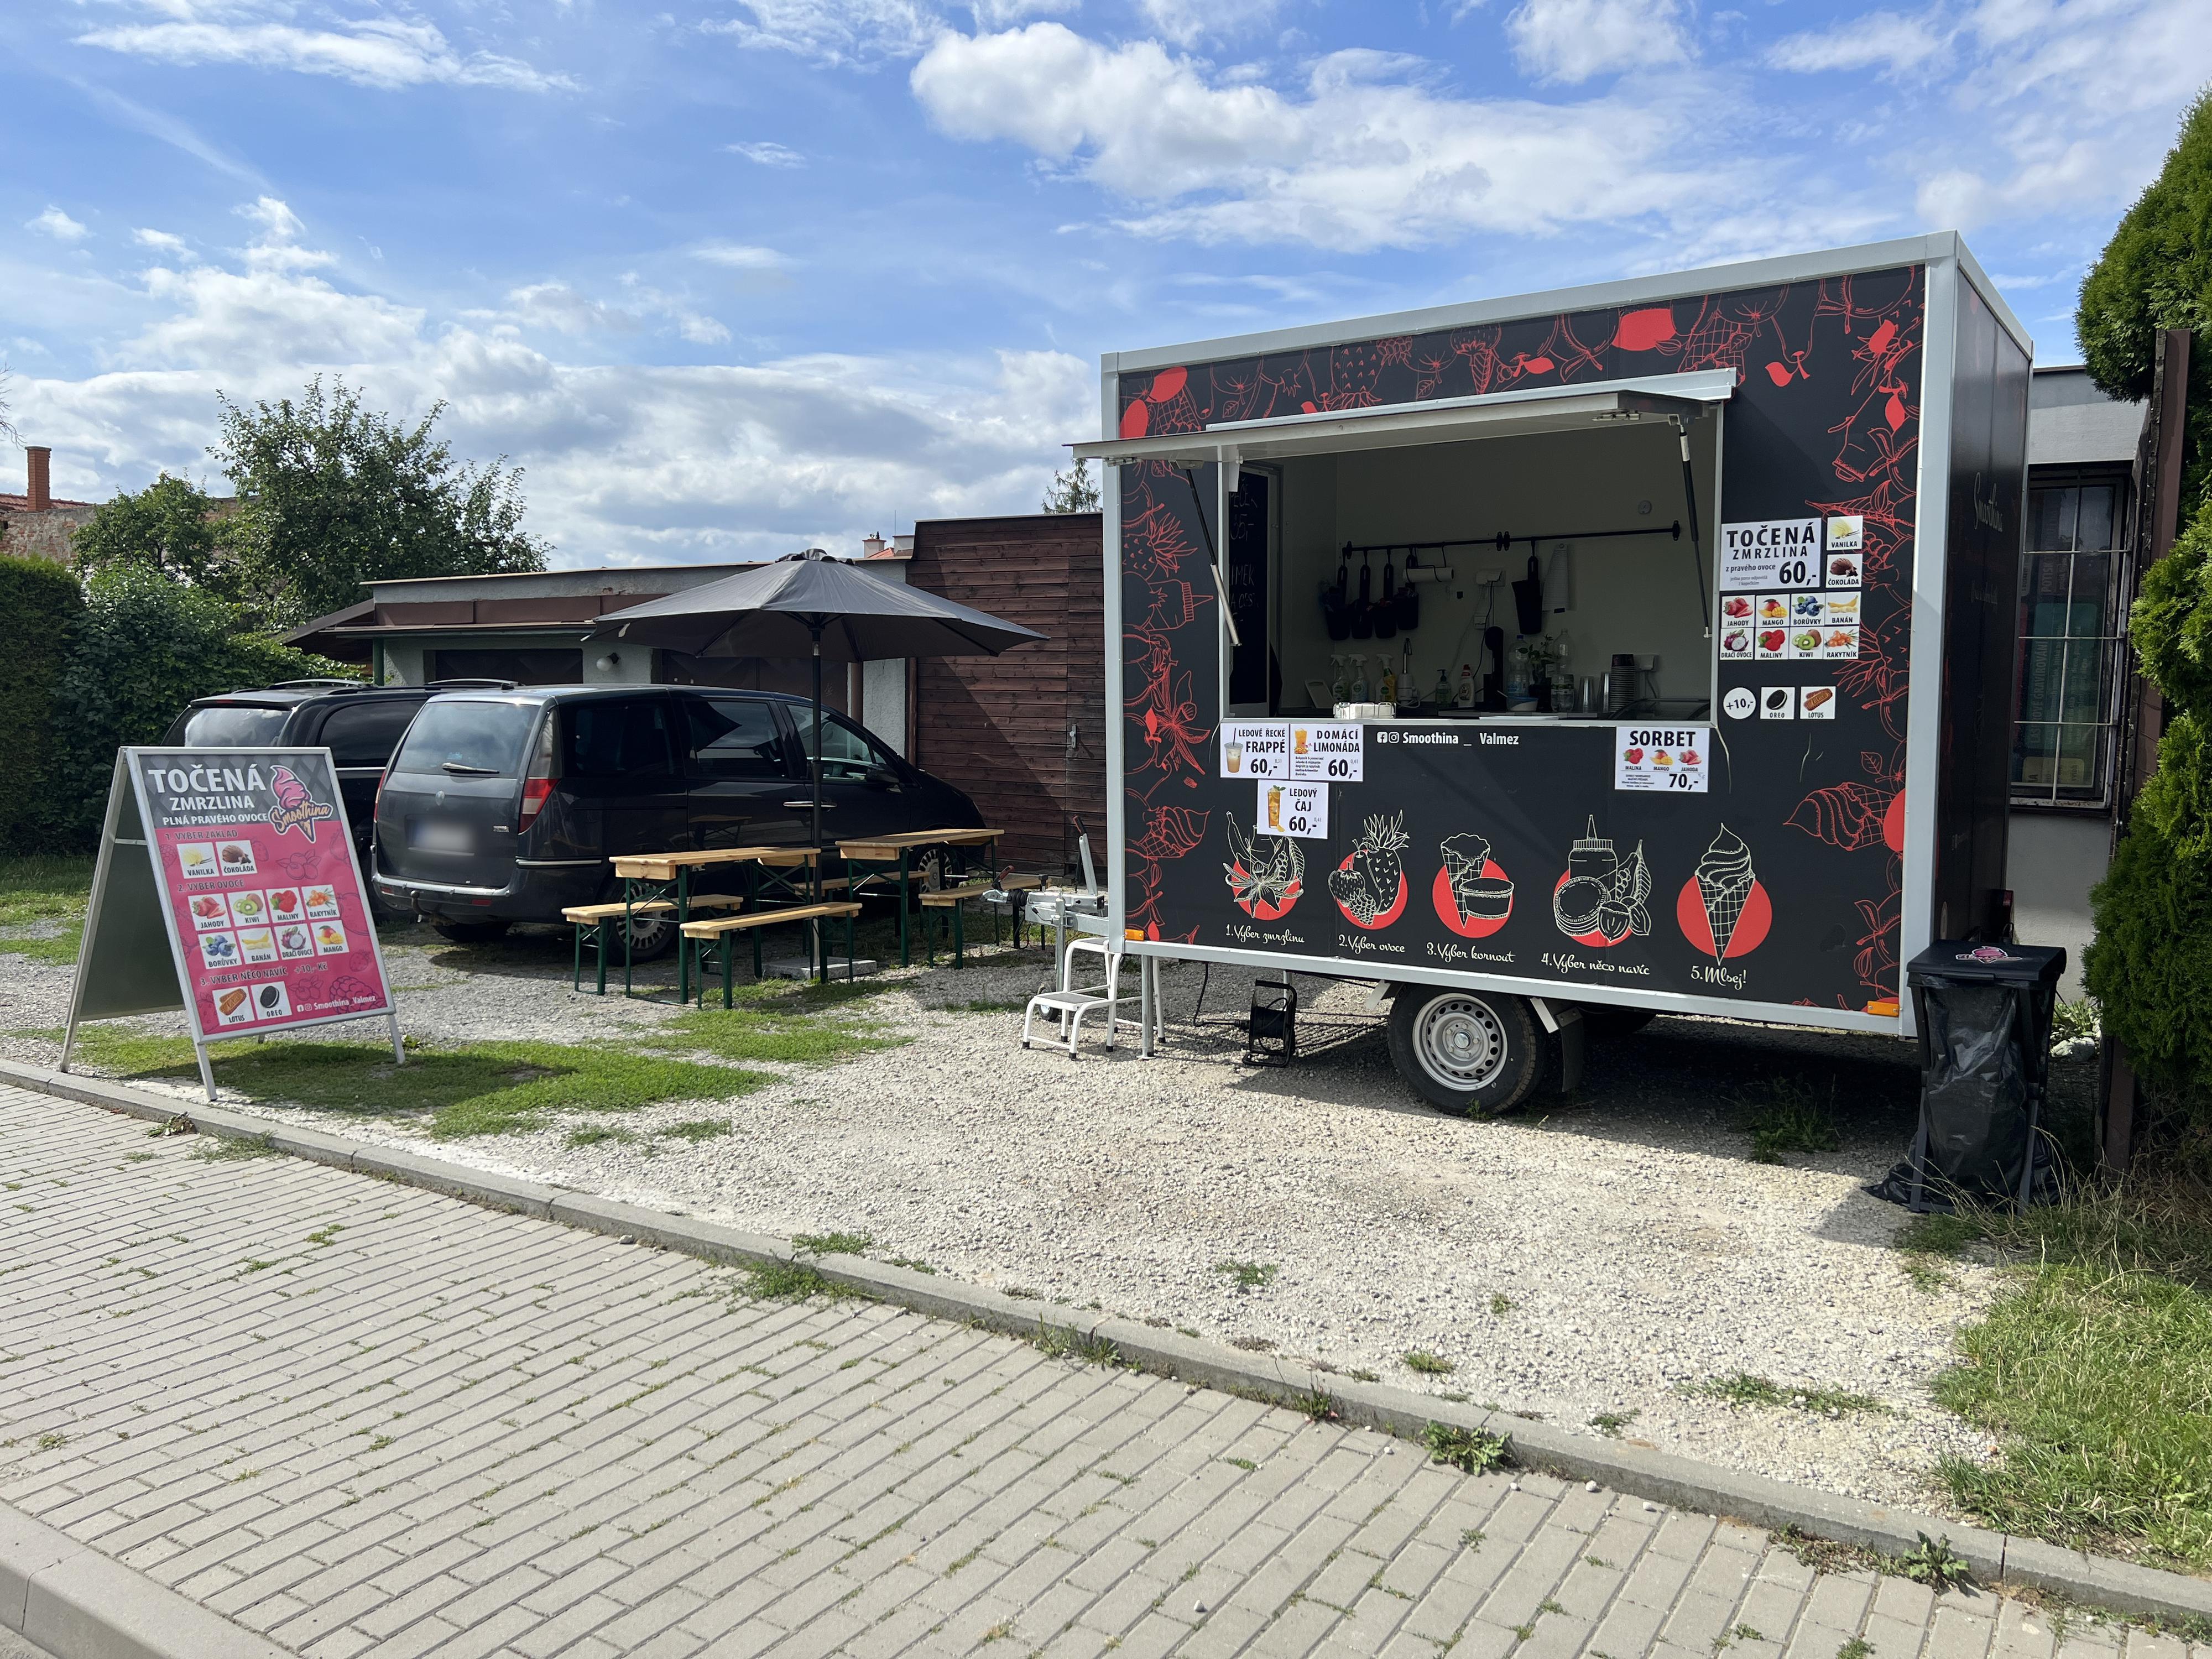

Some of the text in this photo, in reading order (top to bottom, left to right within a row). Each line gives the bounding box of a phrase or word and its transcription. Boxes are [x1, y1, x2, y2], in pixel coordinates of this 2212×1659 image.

[1726, 522, 1815, 547] TOČENÁ
[1733, 546, 1807, 560] ZMRZLINA
[1730, 564, 1756, 573] pravého
[1779, 560, 1817, 586] 60,-
[1828, 577, 1859, 586] ČOKOLÁDA
[1793, 617, 1822, 625] BORŮVKY
[1726, 698, 1754, 710] +10,-
[1239, 728, 1285, 737] LEDOVÉ ŘECKÉ
[1317, 729, 1359, 739] DOMÁCÍ
[1403, 732, 1459, 744] Smoothina
[1479, 732, 1519, 745] Valmez
[1630, 730, 1695, 747] SORBET
[1246, 739, 1285, 753] FRAPPÉ
[1313, 740, 1360, 753] LIMONÁDA
[1250, 758, 1277, 776] 60,-
[1328, 759, 1357, 779] 60,-
[148, 764, 267, 793] TOČENÁ
[1669, 773, 1698, 790] 70,-
[1290, 788, 1317, 797] LEDOVÝ
[169, 795, 255, 811] ZMRZLINA
[1295, 799, 1311, 812] ČAJ
[163, 813, 268, 826] PLNÁ PRAVÉHO OVOCE
[271, 801, 330, 830] Smoothina
[1289, 816, 1317, 835] 60,-
[175, 831, 204, 840] VYBER
[223, 865, 255, 874] ČOKOLÁDA
[187, 881, 215, 891] VYBER
[217, 879, 244, 889] OVOCE
[309, 909, 338, 918] RAKYTNÍK
[200, 920, 225, 929] JAHODY
[1263, 929, 1305, 946] zmrzlinu
[1379, 943, 1405, 953] ovoce
[1471, 946, 1516, 963] kornout
[208, 958, 238, 968] BORŮVKY
[251, 953, 272, 962] BANÁN
[1589, 959, 1615, 972] něco
[1618, 964, 1651, 975] navíc
[200, 978, 210, 987] 3.
[211, 974, 238, 984] VYBER
[228, 1014, 245, 1023] LOTUS
